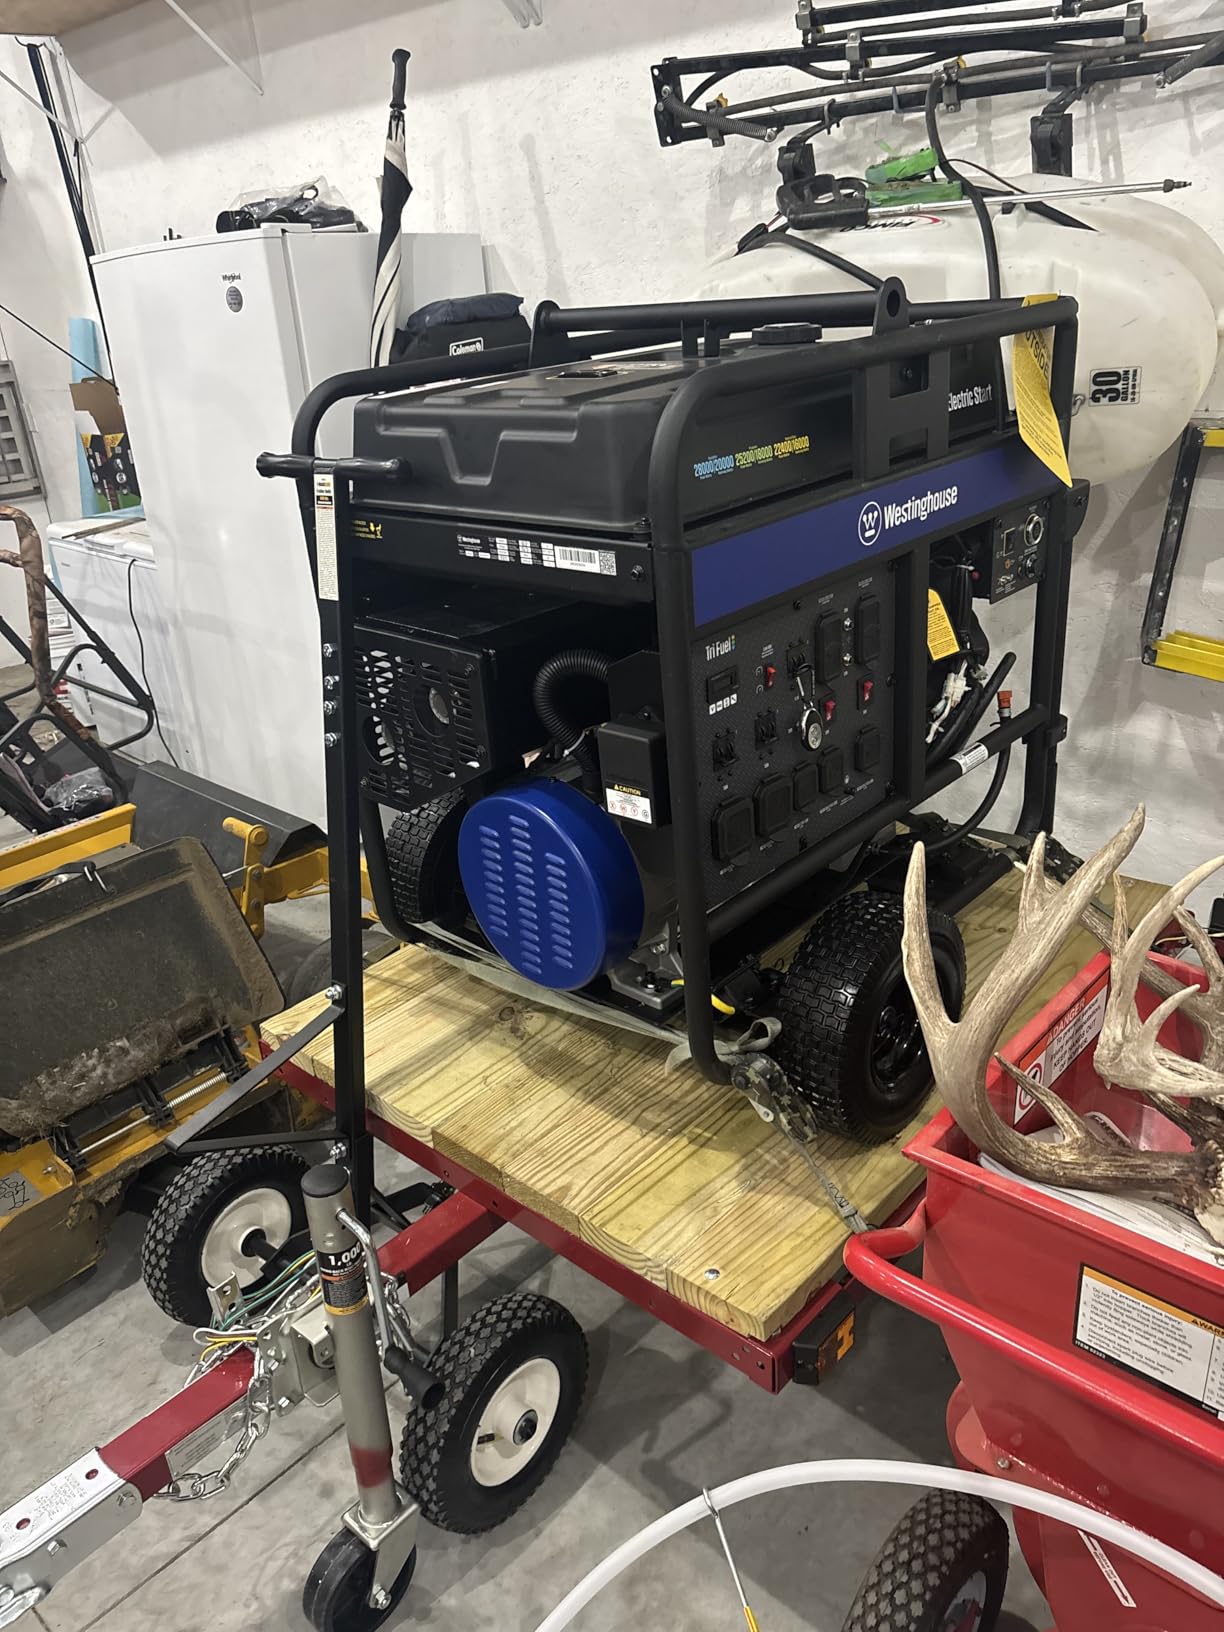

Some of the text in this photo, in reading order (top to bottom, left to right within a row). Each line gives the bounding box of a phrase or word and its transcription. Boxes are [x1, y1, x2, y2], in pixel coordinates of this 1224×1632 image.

[973, 383, 993, 405] Start
[1091, 370, 1122, 403] 30
[1120, 369, 1131, 402] GALLON
[884, 485, 958, 530] Westinghouse
[705, 635, 732, 662] Tri Fuel
[619, 785, 642, 797] CAUTION
[1053, 997, 1086, 1041] DANGER
[328, 1241, 361, 1266] 1,000
[1198, 1318, 1224, 1337] WAR
